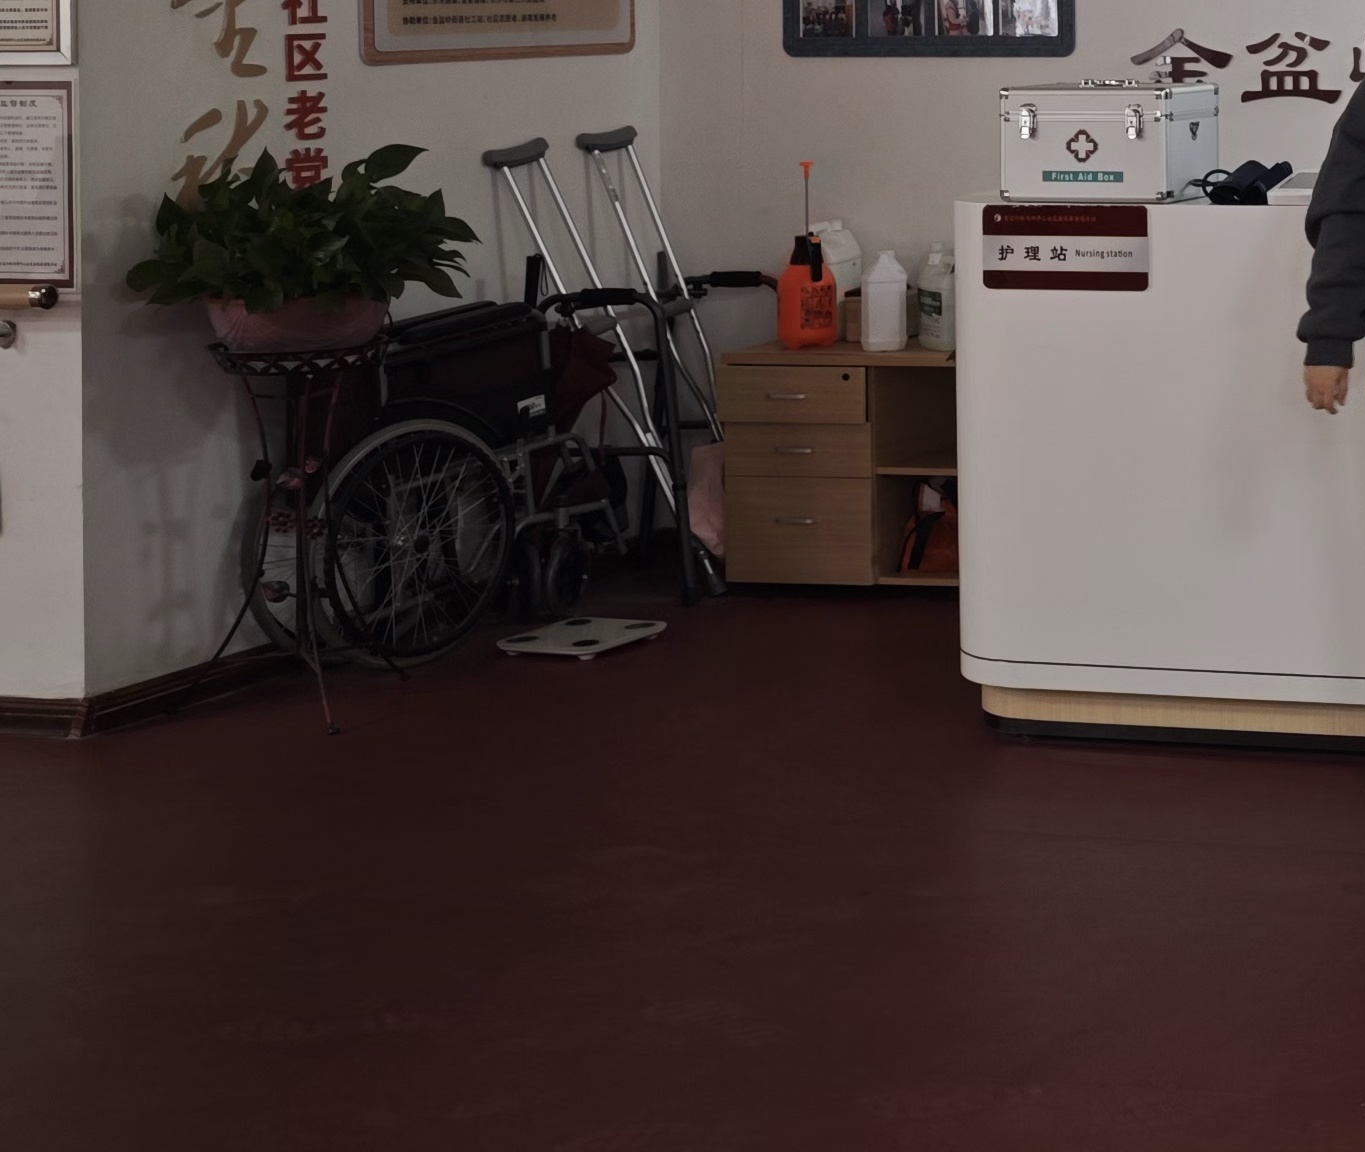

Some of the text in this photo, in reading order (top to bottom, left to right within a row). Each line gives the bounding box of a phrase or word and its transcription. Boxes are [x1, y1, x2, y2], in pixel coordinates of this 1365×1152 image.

[1052, 172, 1115, 182] First Aid Box
[998, 244, 1068, 262] 护理站
